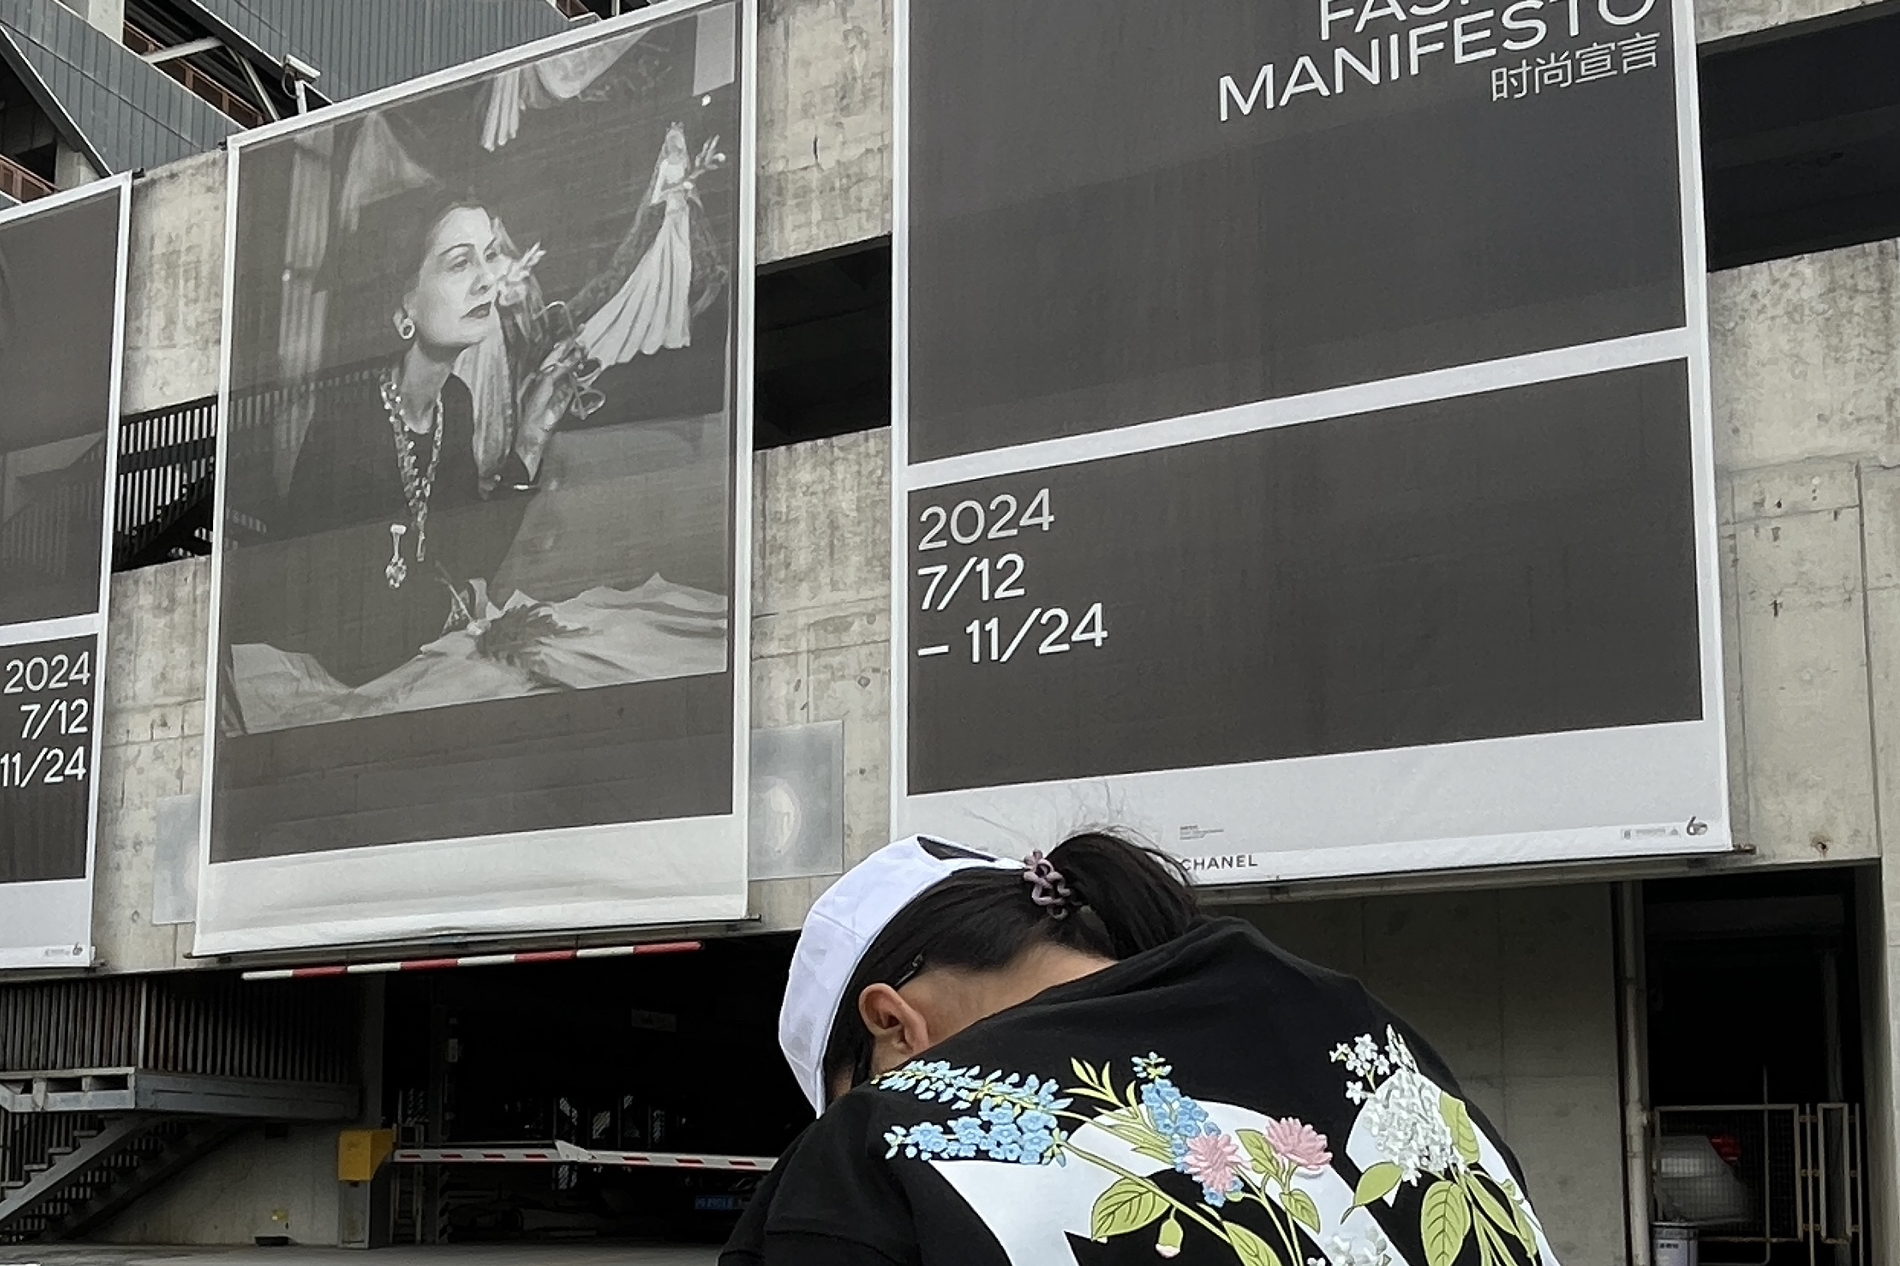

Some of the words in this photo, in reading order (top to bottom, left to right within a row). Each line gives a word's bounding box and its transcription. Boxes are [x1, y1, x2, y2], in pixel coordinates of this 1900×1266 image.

[1320, 0, 1470, 41] FA
[1491, 32, 1661, 101] 时尚宣言
[918, 488, 1055, 550] 2024
[917, 553, 1025, 610] 7/12
[965, 602, 1108, 663] 11/24
[4, 651, 91, 694] 2024
[20, 698, 88, 740] 7/12
[0, 746, 87, 788] 11/24
[1180, 854, 1258, 872] CHANEL
